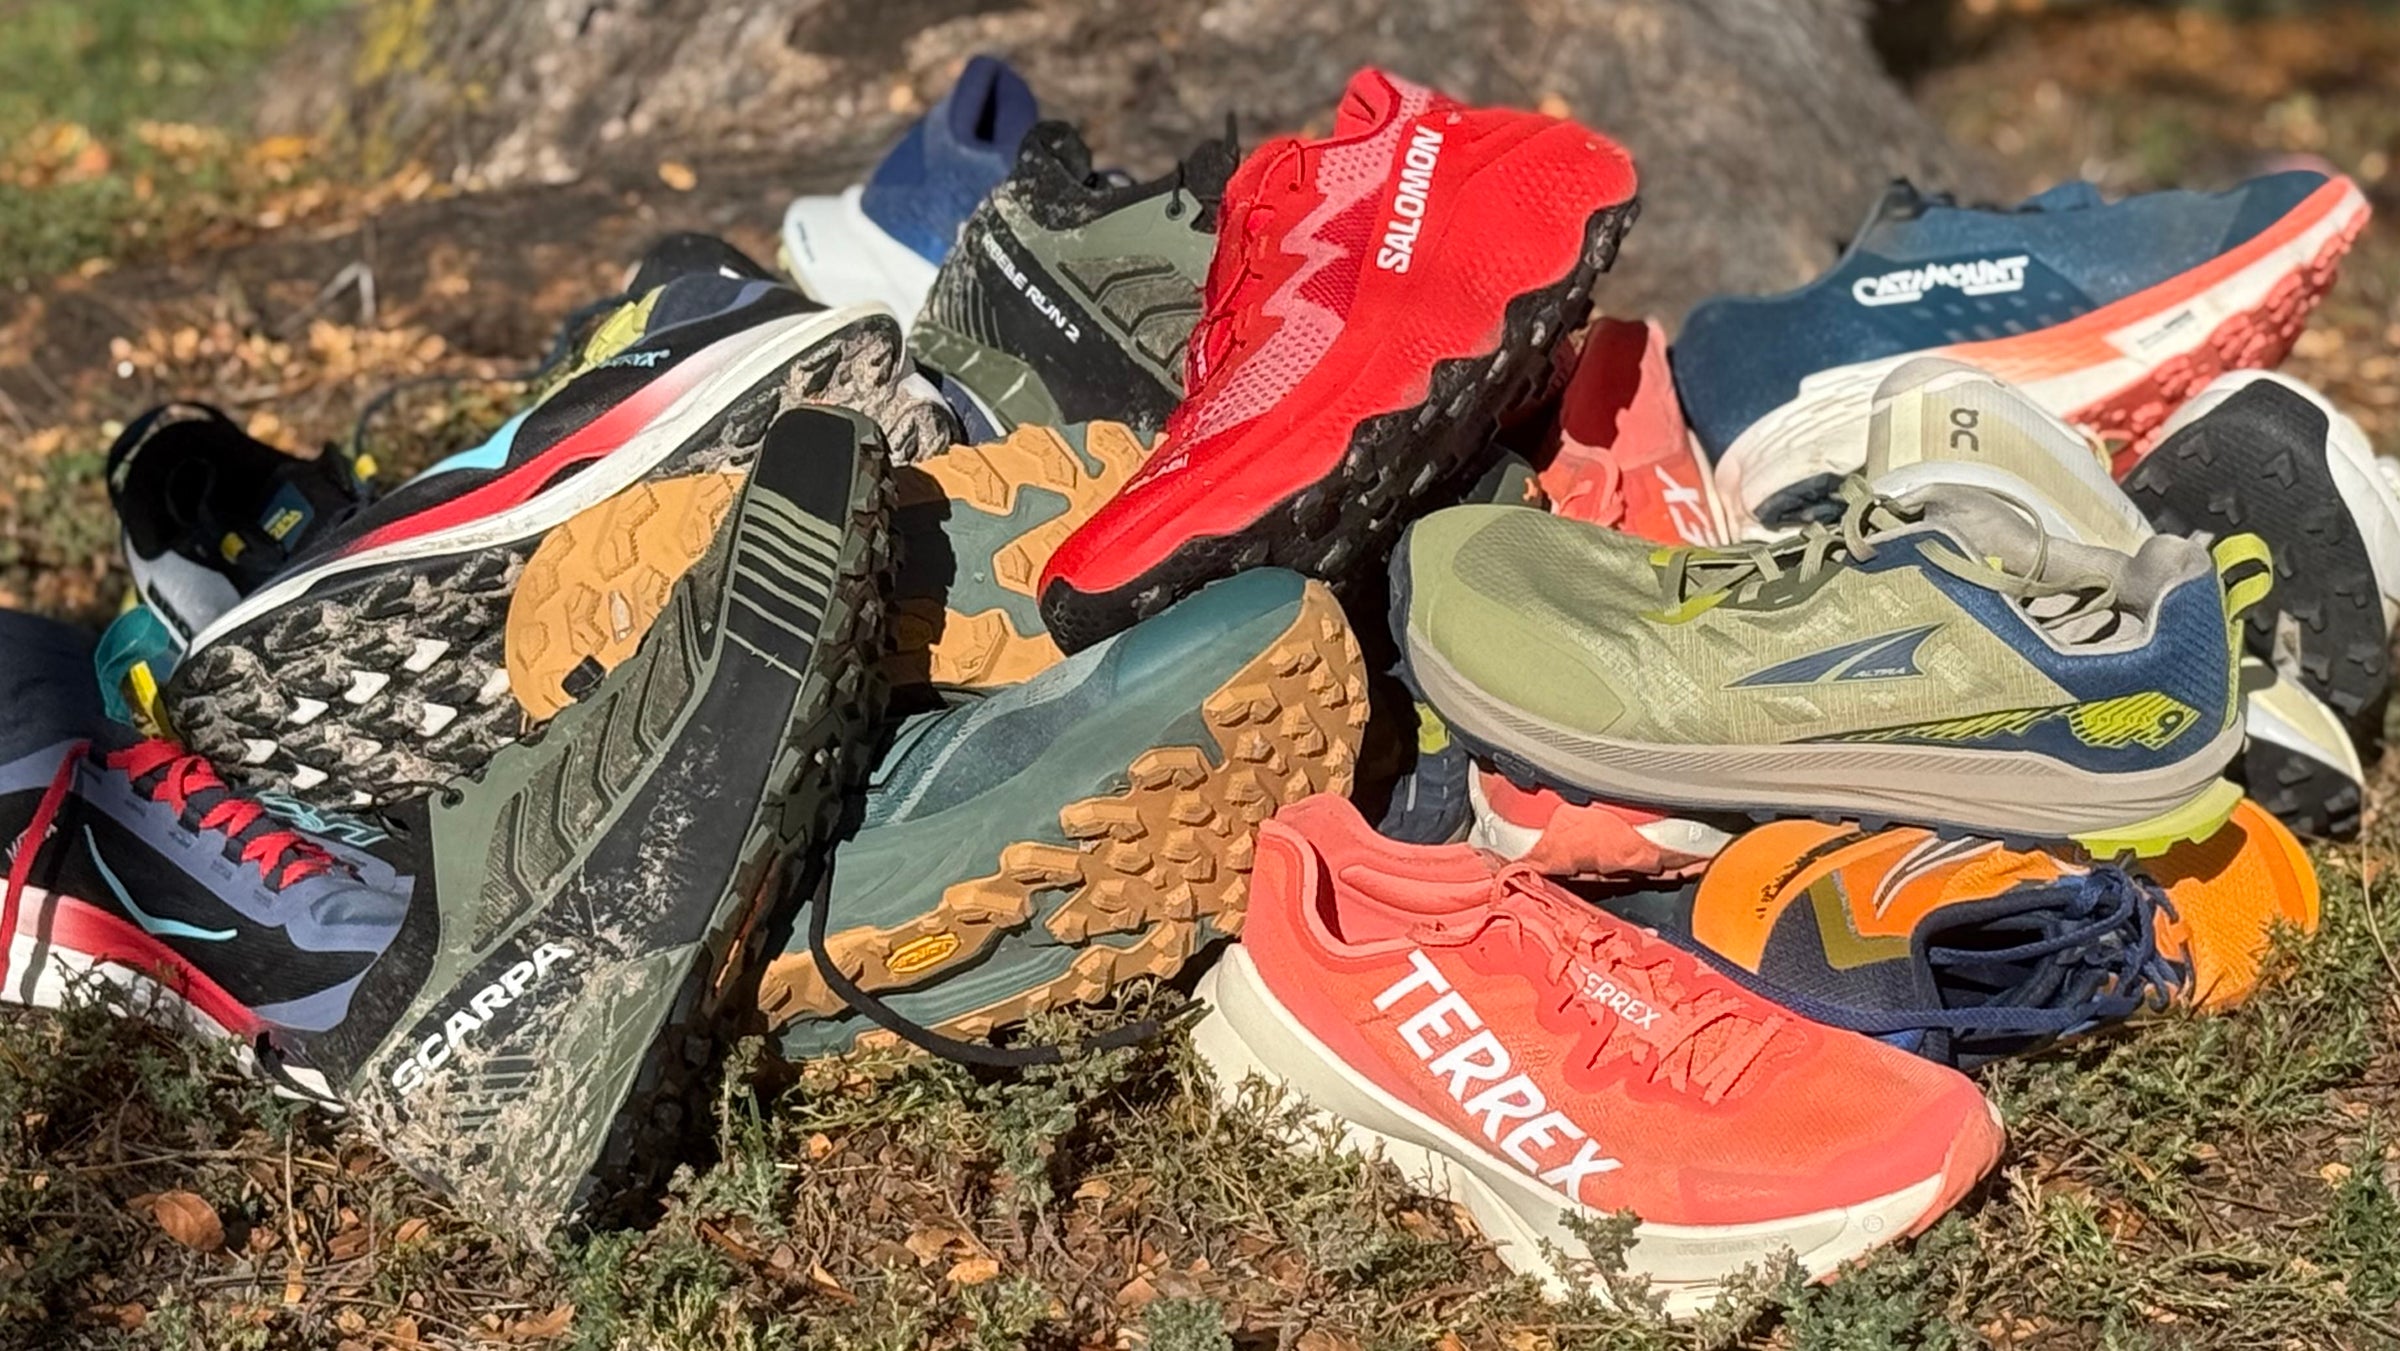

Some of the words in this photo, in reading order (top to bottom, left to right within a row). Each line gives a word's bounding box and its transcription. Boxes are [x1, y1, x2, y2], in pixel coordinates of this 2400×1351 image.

[1376, 124, 1444, 274] SALOMON
[1025, 284, 1067, 329] RUN
[1064, 323, 1080, 344] 2
[1852, 254, 2030, 307] CATAMOUNT
[392, 942, 576, 1096] SCARPA
[1579, 963, 1663, 1031] ERREX
[1372, 948, 1624, 1204] TERREX
